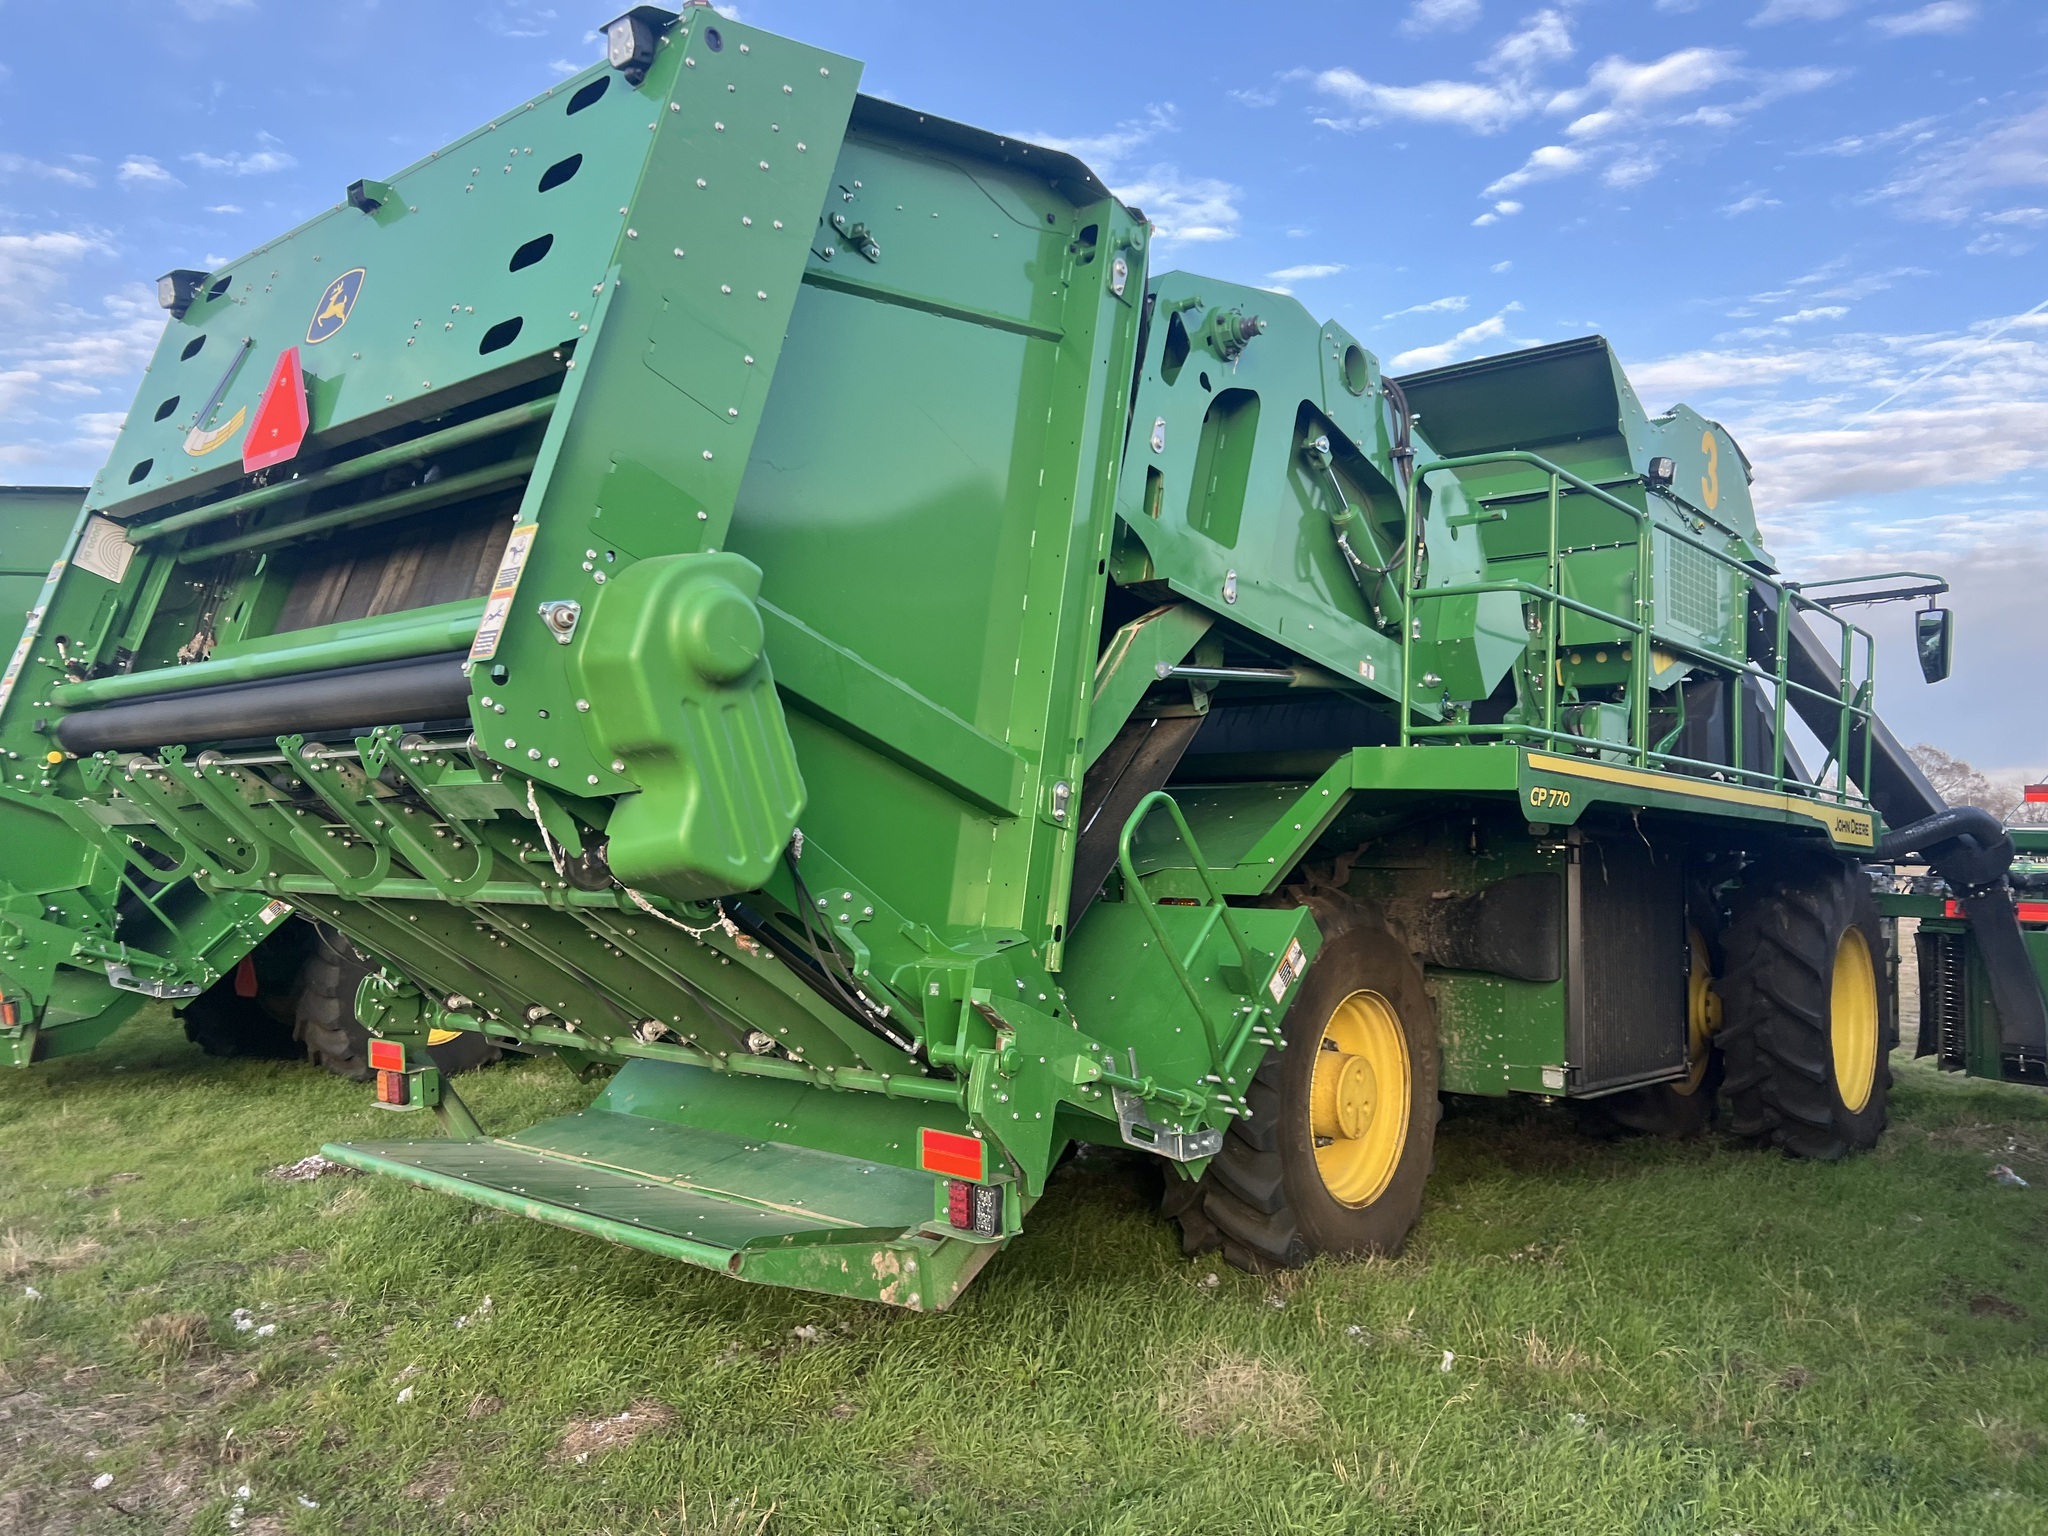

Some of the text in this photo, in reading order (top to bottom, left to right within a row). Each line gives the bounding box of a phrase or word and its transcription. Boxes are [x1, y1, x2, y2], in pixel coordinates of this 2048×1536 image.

[1701, 431, 1718, 510] 3
[1530, 786, 1571, 808] CP 770
[1835, 816, 1869, 836] JOHN DEERE
